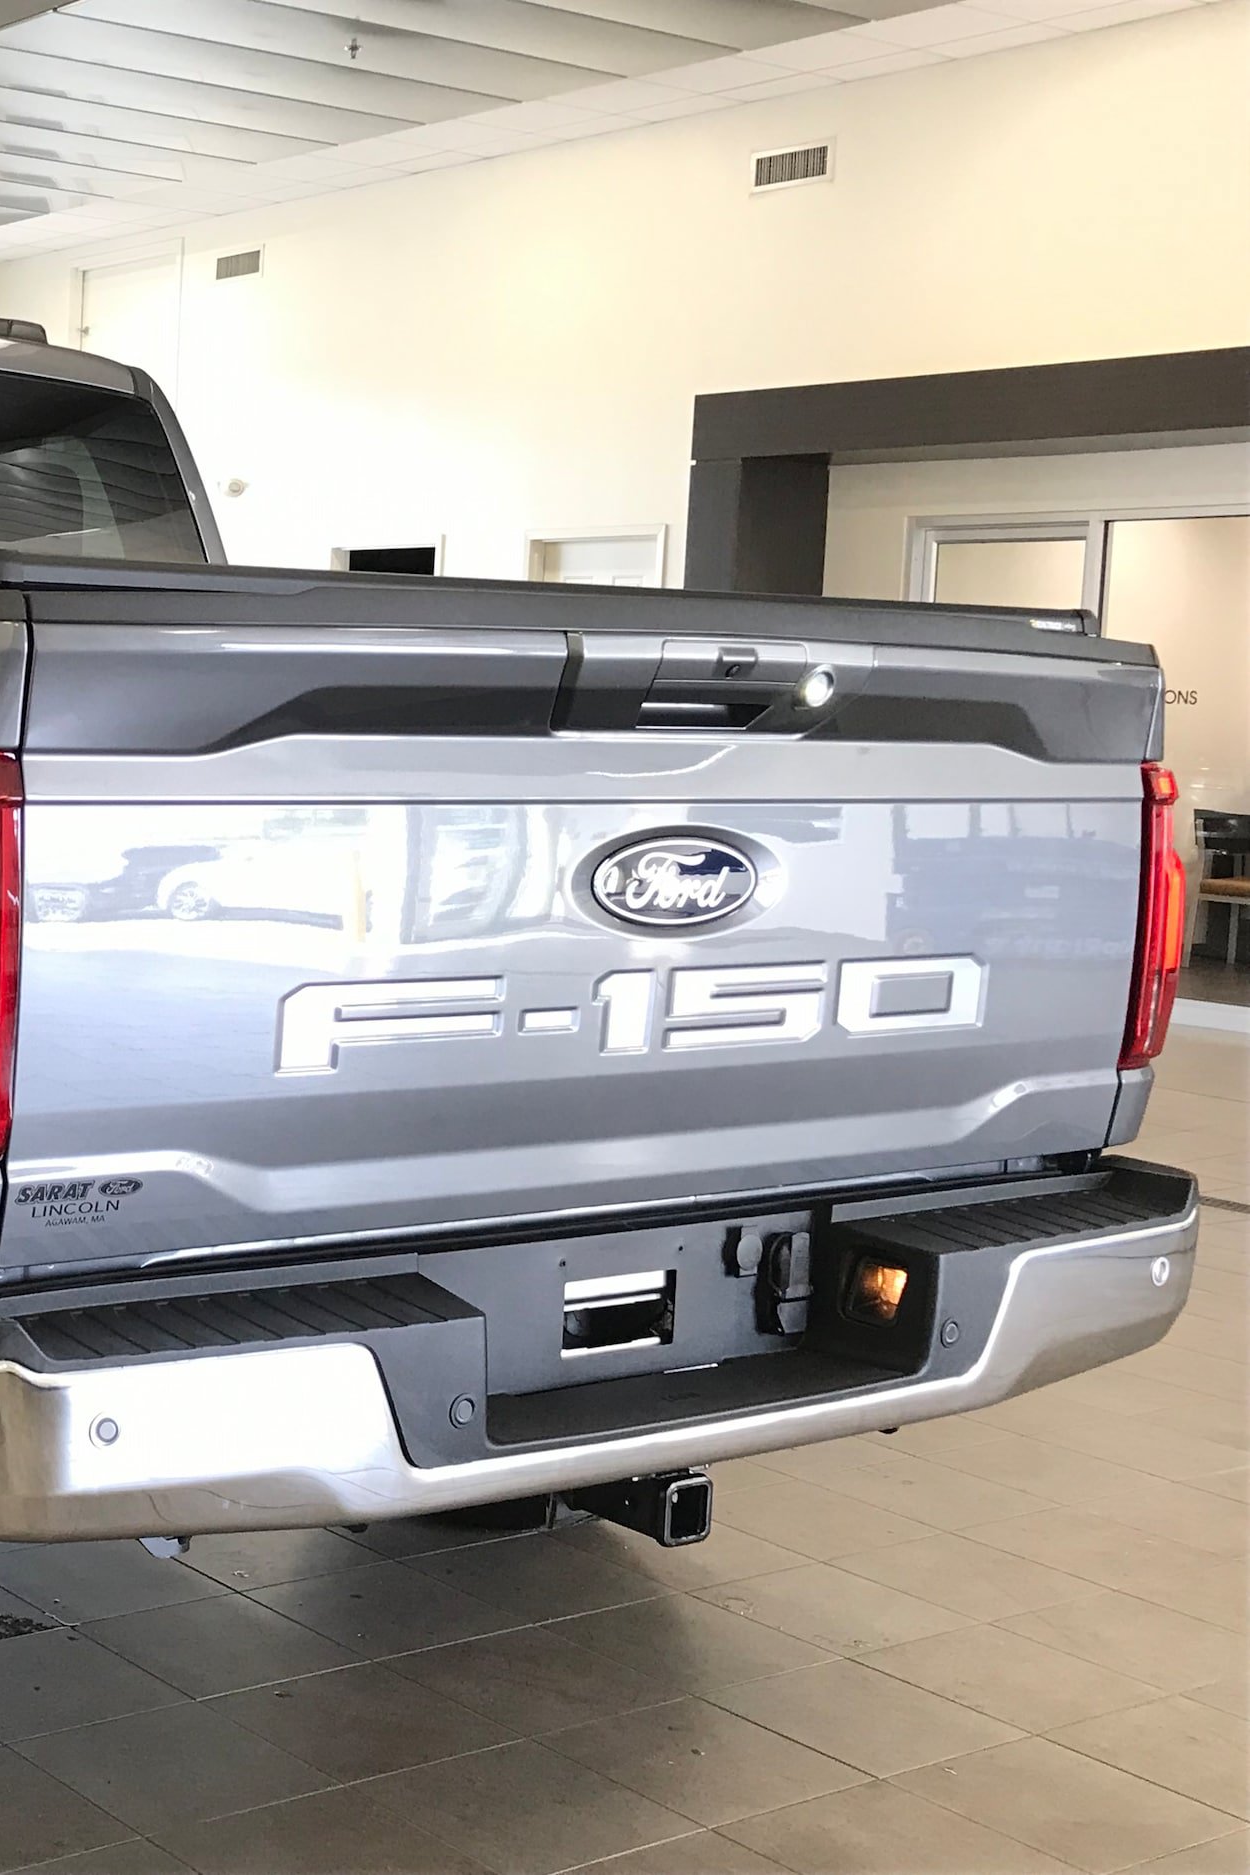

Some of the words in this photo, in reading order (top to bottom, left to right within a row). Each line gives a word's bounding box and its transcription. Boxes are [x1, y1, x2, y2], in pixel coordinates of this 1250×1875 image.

[273, 953, 987, 1075] F-150
[17, 1181, 94, 1204] SARAT
[31, 1200, 120, 1218] LINCOLN
[91, 1215, 105, 1223] MA
